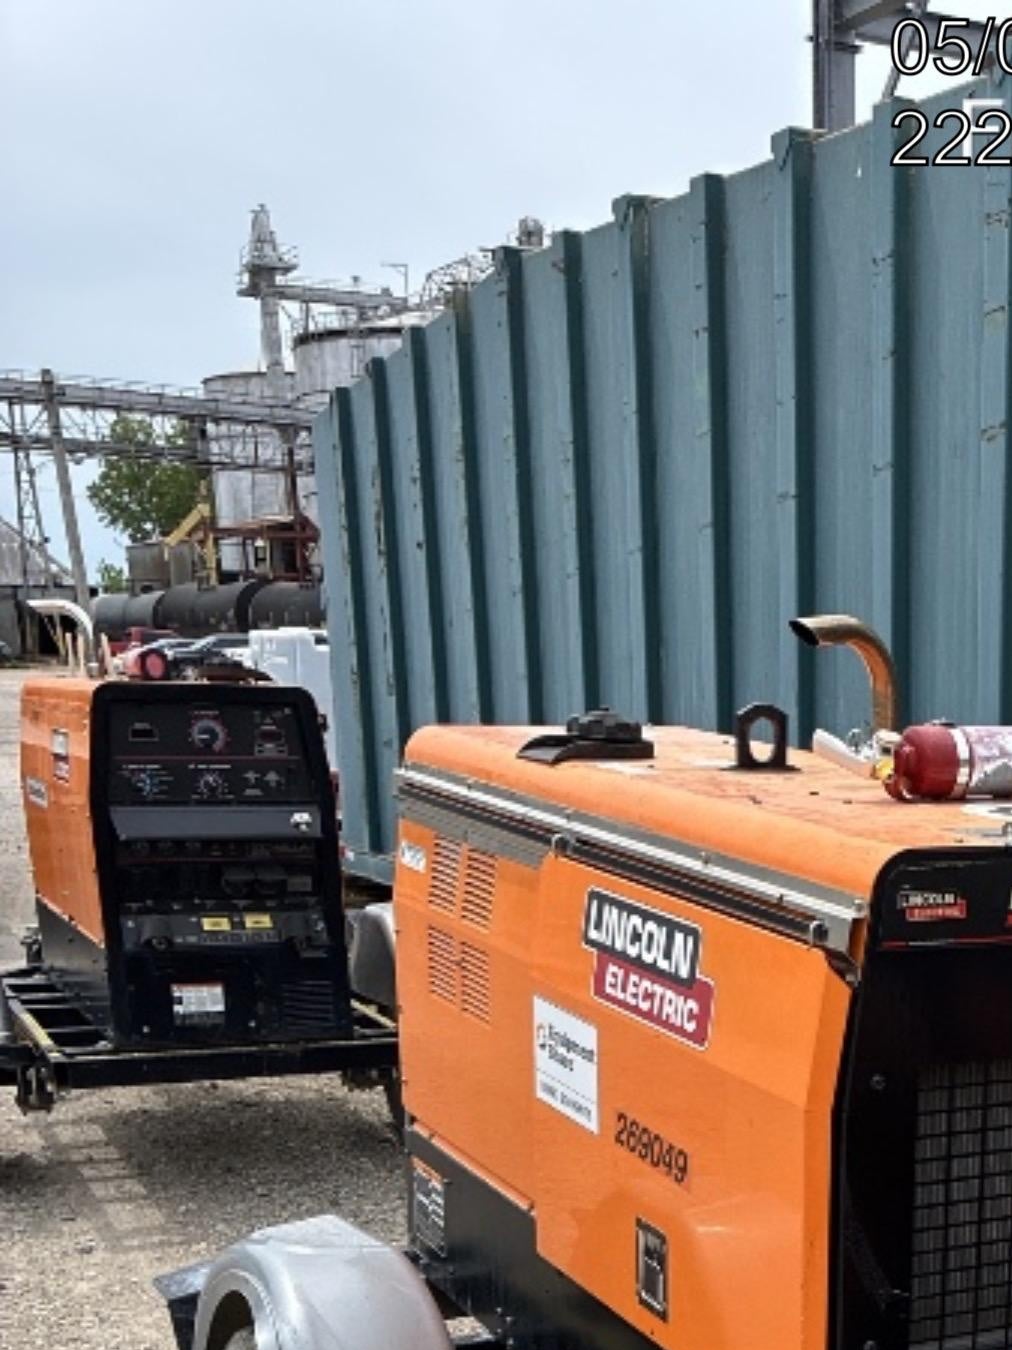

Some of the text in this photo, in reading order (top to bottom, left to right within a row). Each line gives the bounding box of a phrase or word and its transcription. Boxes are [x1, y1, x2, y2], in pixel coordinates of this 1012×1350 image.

[587, 899, 694, 979] LINCOLN
[604, 963, 699, 1033] ELECTRIC
[615, 1112, 688, 1186] 269049
